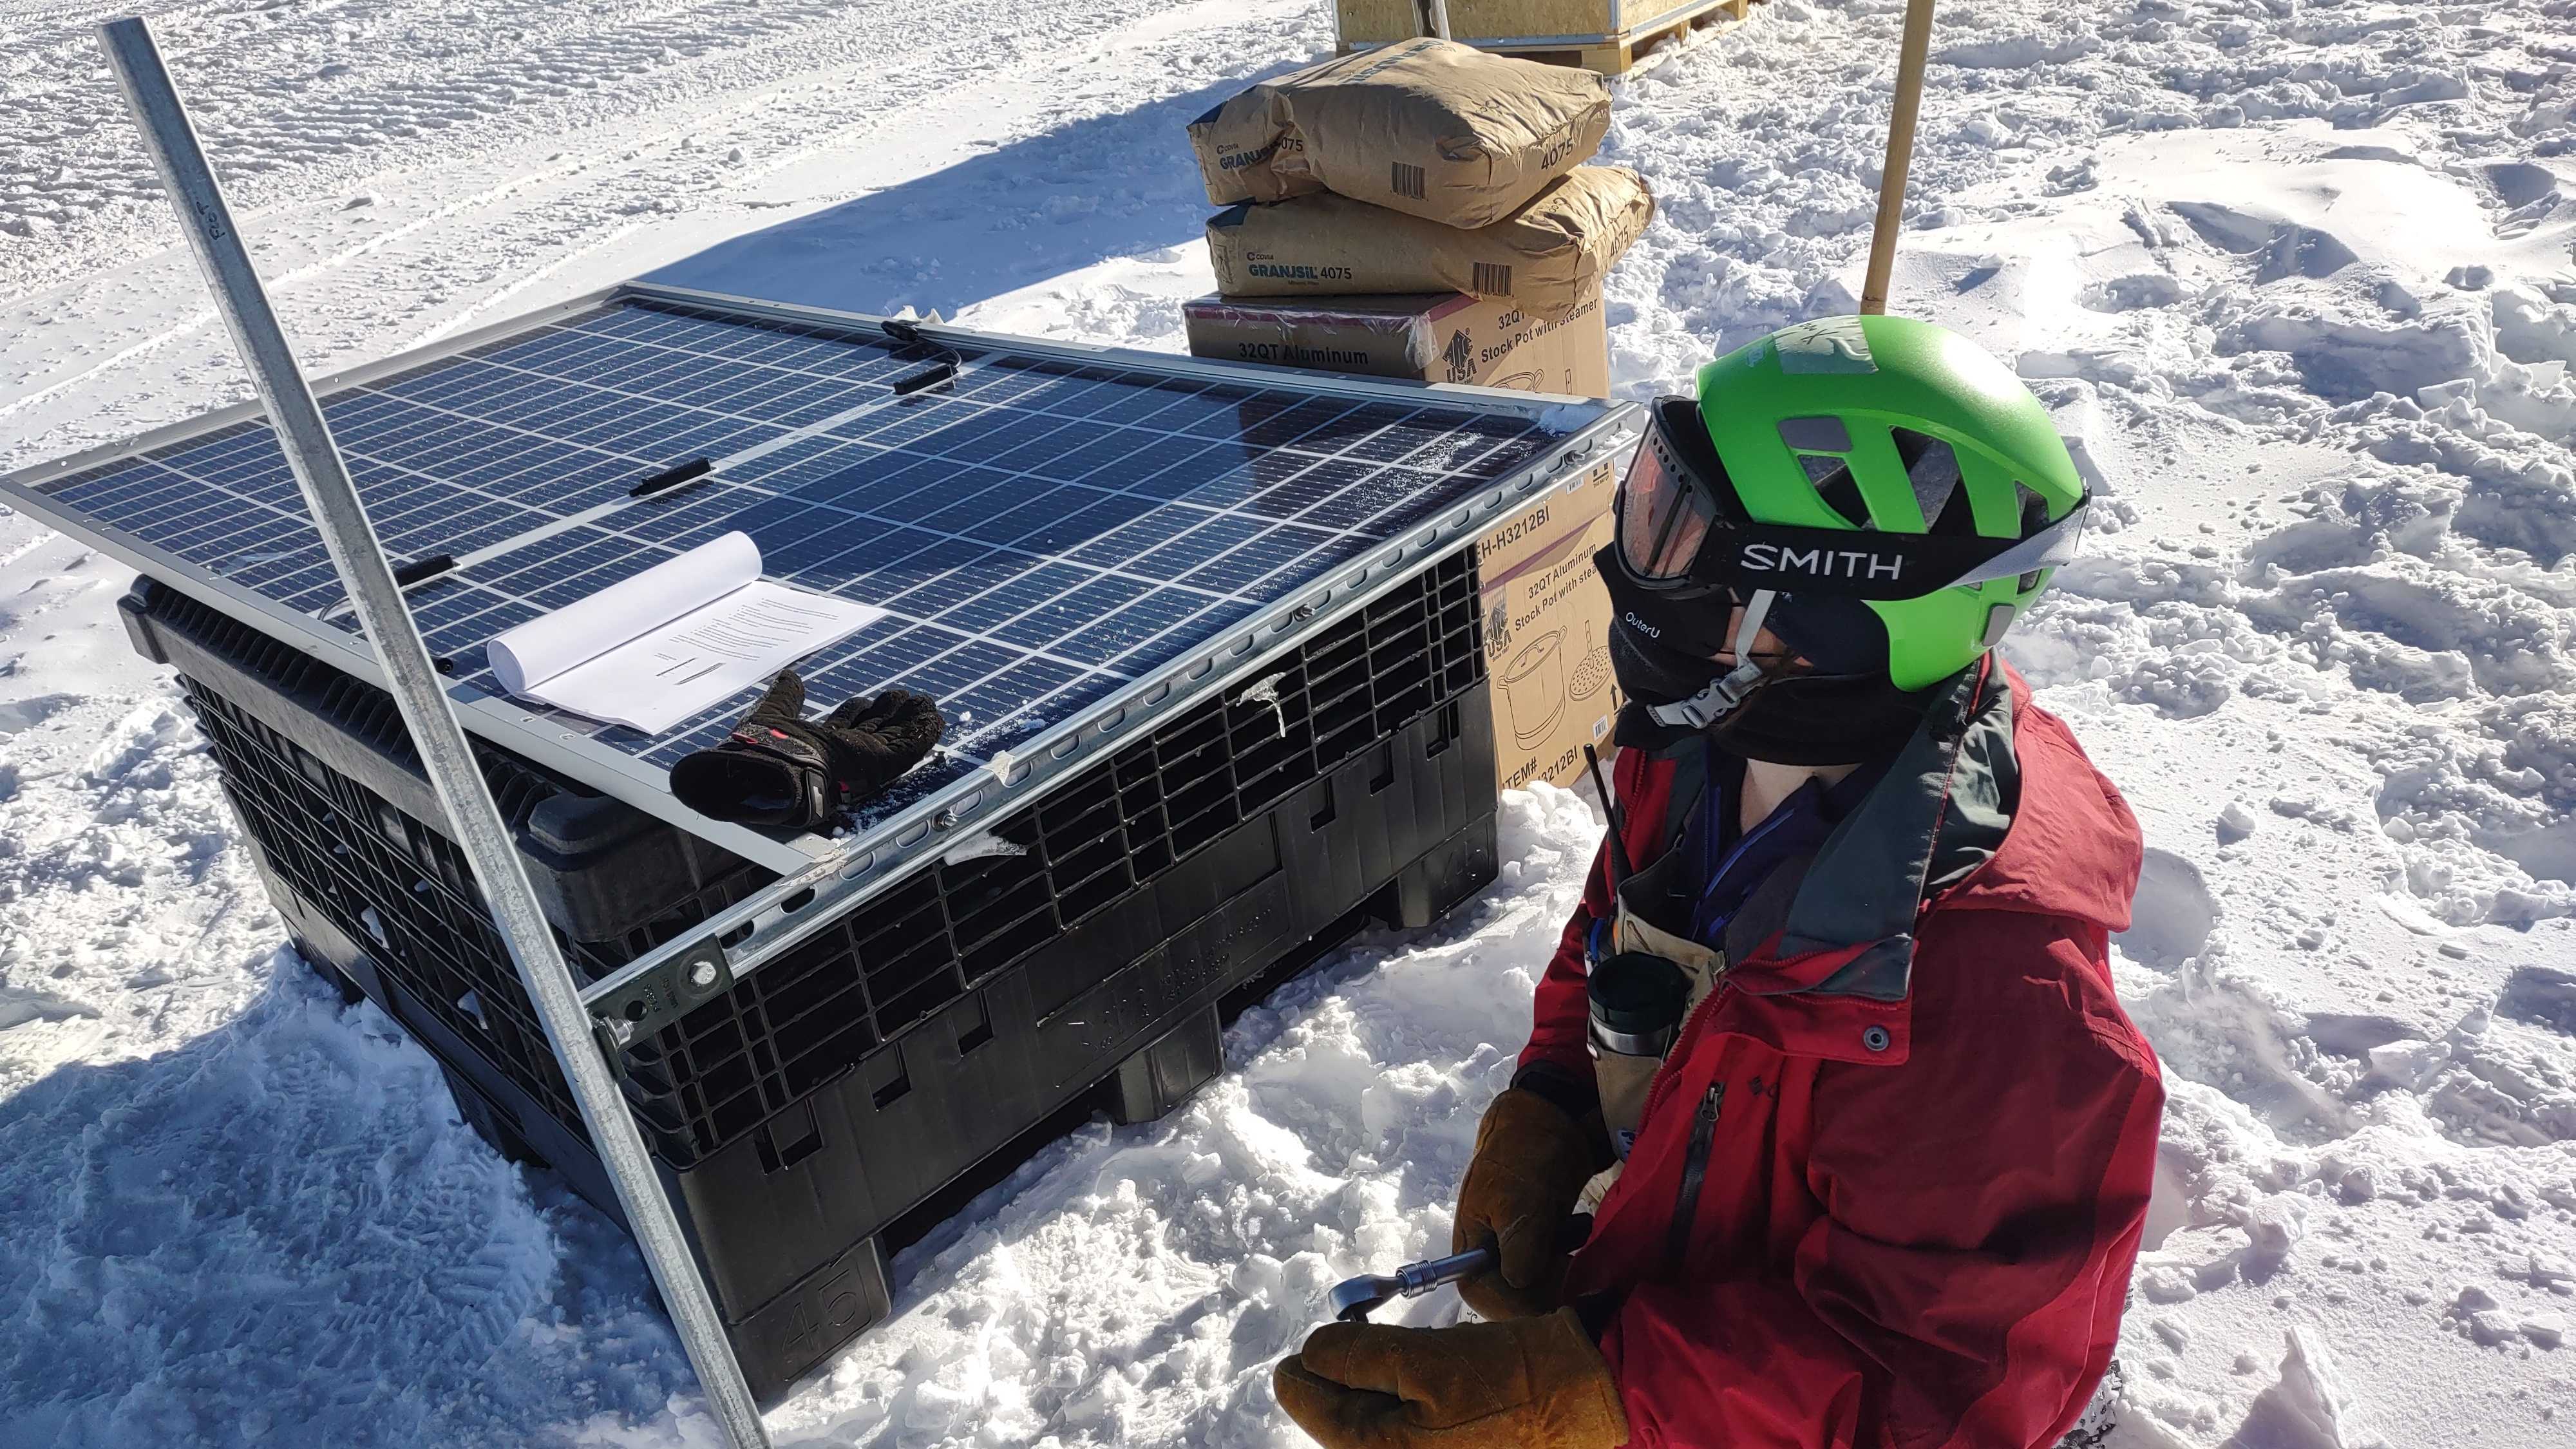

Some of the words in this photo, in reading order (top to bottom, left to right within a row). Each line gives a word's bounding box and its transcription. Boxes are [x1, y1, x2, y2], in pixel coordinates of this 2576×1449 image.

[1219, 140, 1279, 170] GRANU
[1278, 137, 1303, 152] 075
[1540, 138, 1574, 171] 4075
[1320, 267, 1352, 279] 4075
[1238, 343, 1278, 360] 32QT
[1283, 345, 1368, 365] Aluminum
[1481, 339, 1514, 363] Stock
[1515, 328, 1533, 348] Pot
[1477, 506, 1550, 558] H-H3212BI
[1528, 573, 1551, 600] 32QT
[1553, 544, 1596, 582] Aluminum
[1740, 544, 1903, 580] SMITH
[1515, 604, 1541, 631] Stock
[1542, 592, 1557, 611] Pot
[1558, 578, 1577, 598] with
[1578, 565, 1597, 583] stea
[1625, 612, 1660, 638] OuterU
[1488, 629, 1512, 658] USA
[1537, 744, 1578, 783] 3212BI
